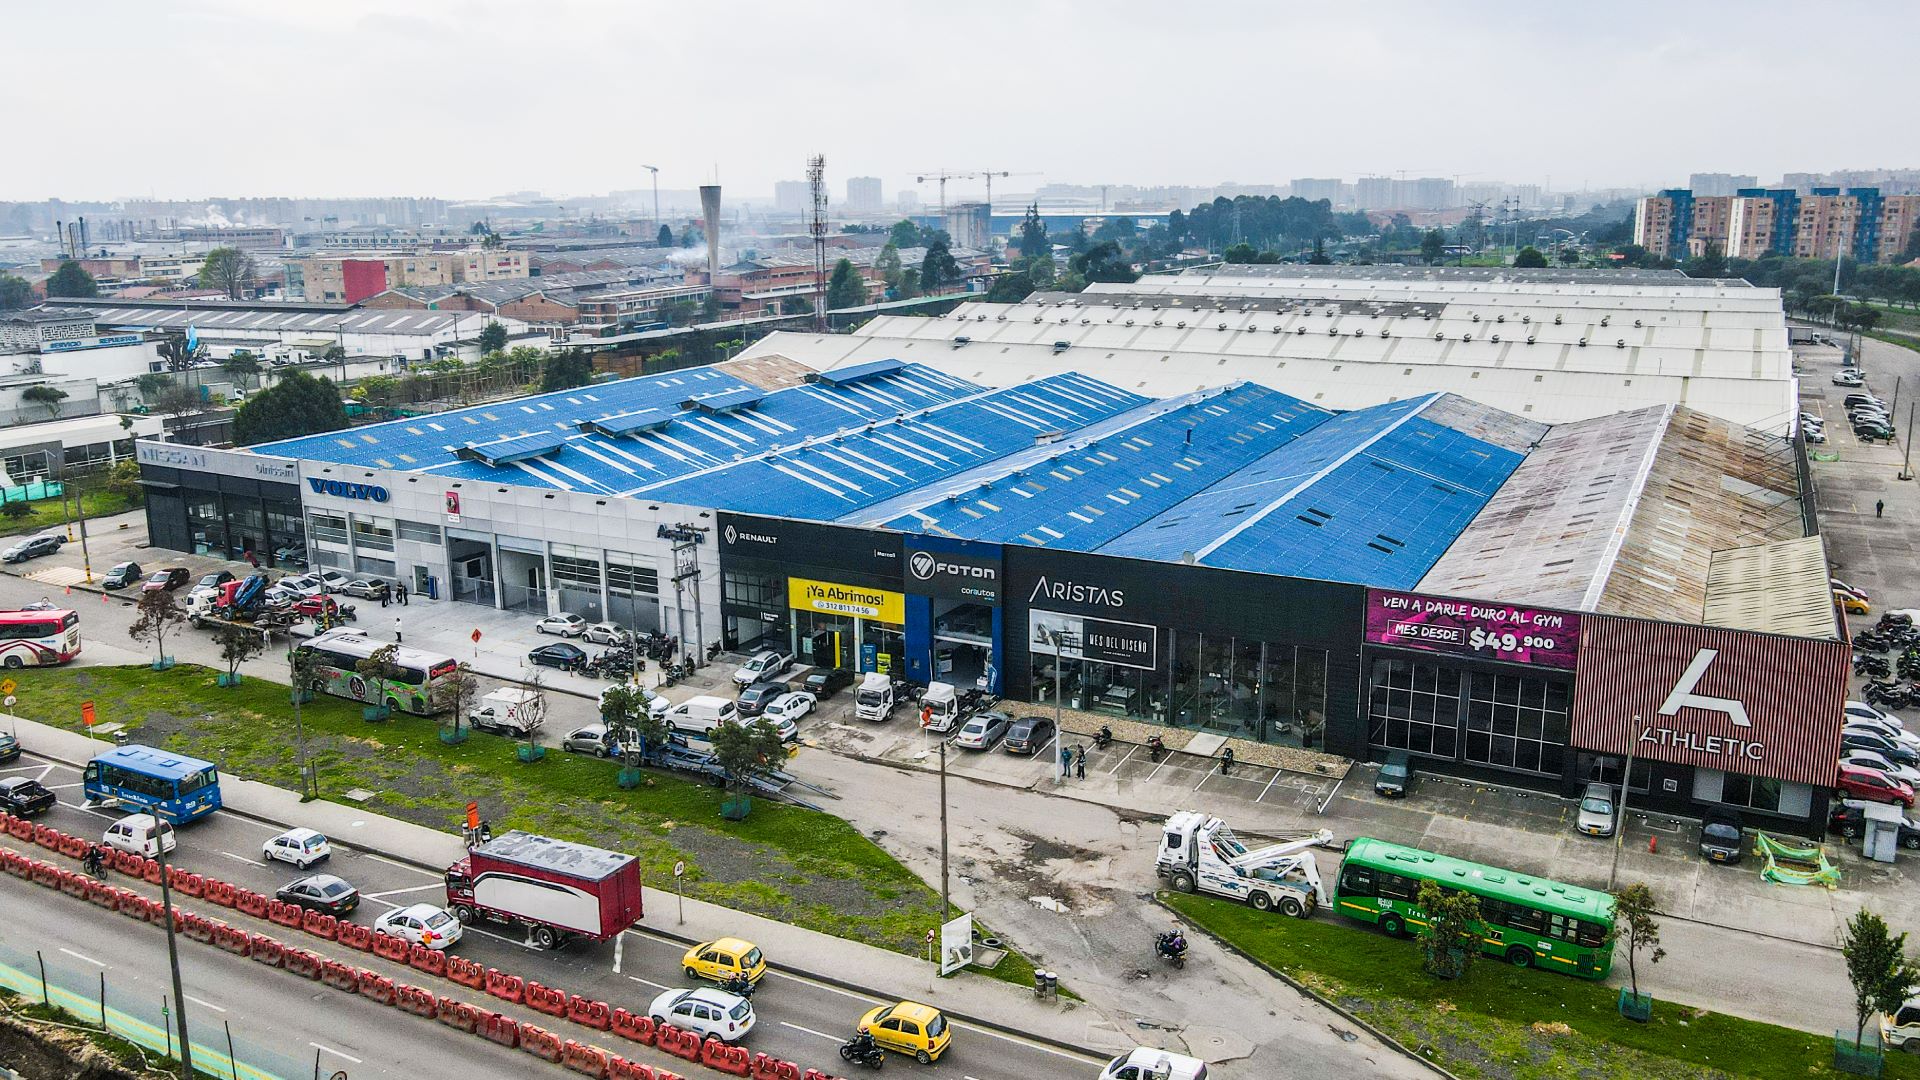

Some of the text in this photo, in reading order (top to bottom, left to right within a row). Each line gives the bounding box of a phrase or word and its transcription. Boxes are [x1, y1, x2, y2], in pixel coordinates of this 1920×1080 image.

[142, 448, 205, 467] NISSAN
[306, 477, 390, 503] VOLVO
[739, 532, 778, 544] RENAULT
[936, 562, 995, 580] FOTON
[806, 584, 884, 606] ¡Ya Abrimos!
[825, 602, 870, 615] 312 811 74 56
[1383, 596, 1563, 628] VEN A DARLE DURO AL GYM
[1395, 623, 1459, 641] MES DESDE
[1089, 633, 1147, 653] MES DEL DISEÑO
[1639, 727, 1765, 760] ATHLETIC
